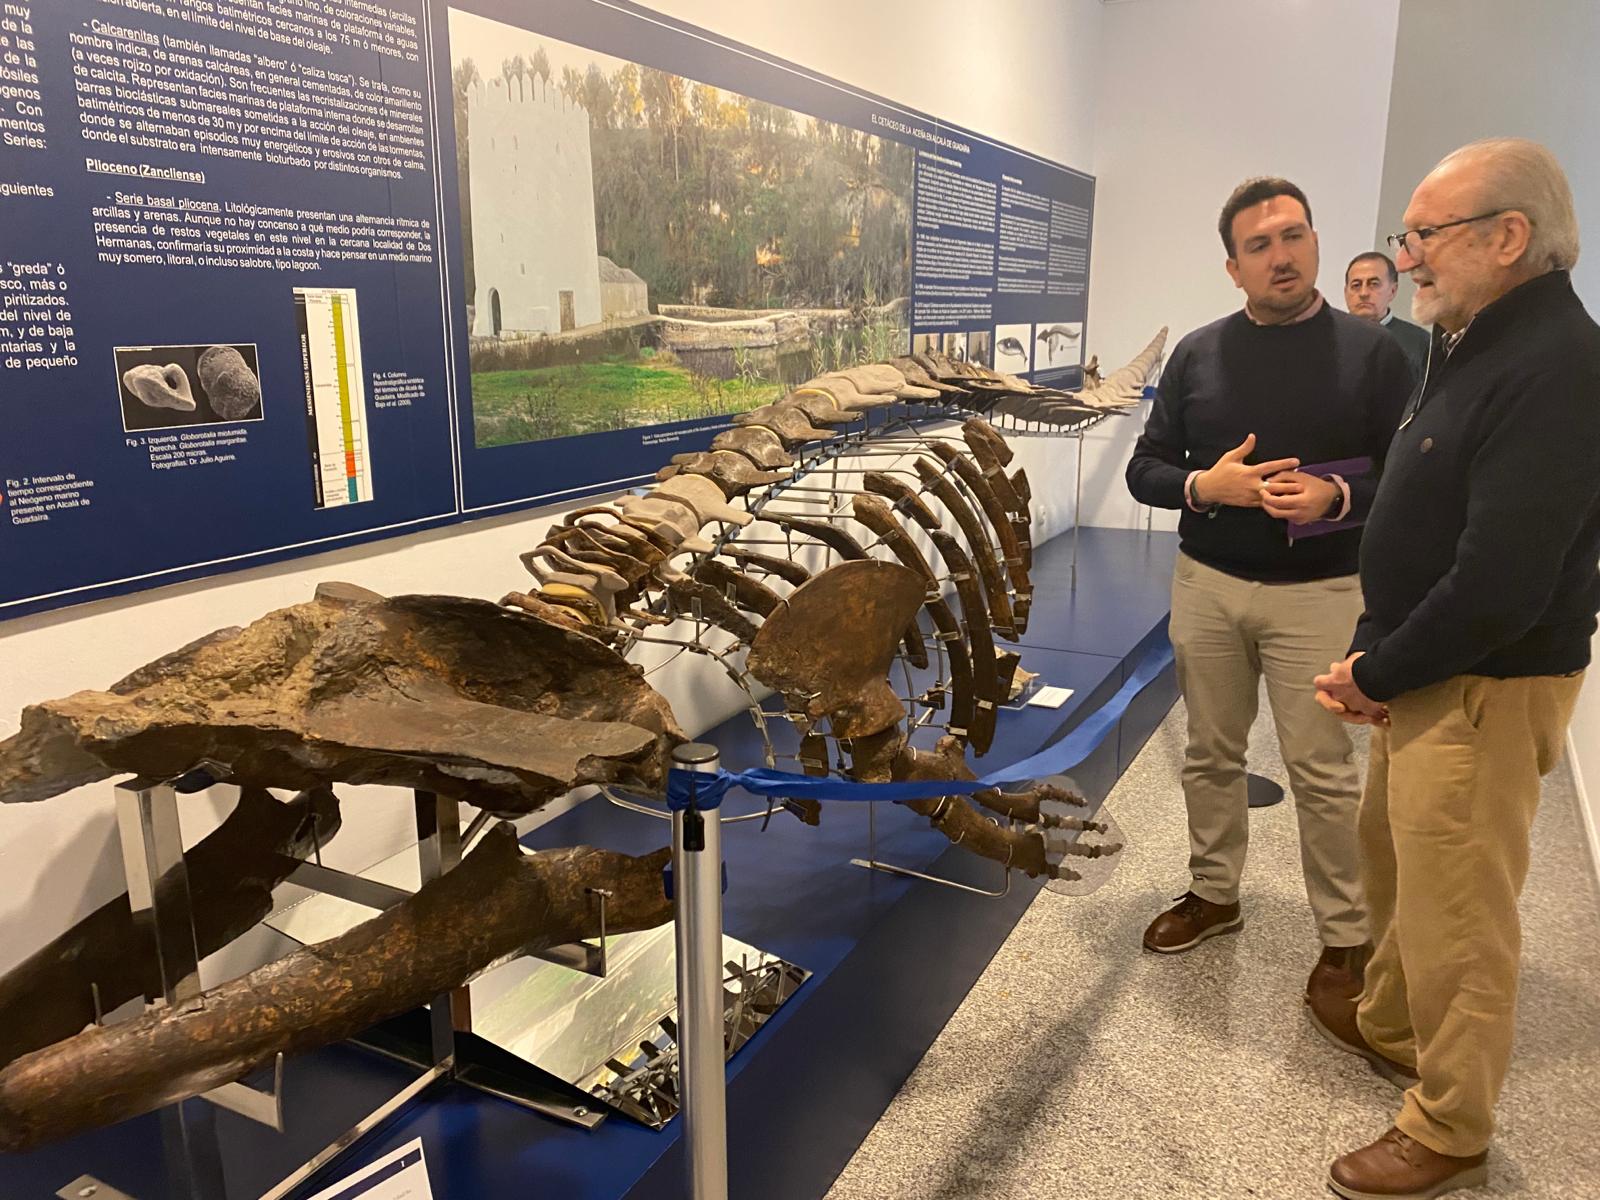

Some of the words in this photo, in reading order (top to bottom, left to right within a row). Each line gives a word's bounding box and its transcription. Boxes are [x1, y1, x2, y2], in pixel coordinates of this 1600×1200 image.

[5, 4, 30, 20] muy
[1, 18, 17, 31] de
[21, 20, 32, 34] la
[16, 36, 35, 50] las
[4, 50, 20, 64] de
[25, 53, 36, 68] la
[91, 19, 160, 44] Calcarenitas
[162, 34, 206, 53] (también
[209, 44, 251, 62] llamadas
[290, 61, 296, 72] ó
[358, 76, 369, 87] Se
[371, 78, 389, 93] trata,
[391, 85, 411, 96] como
[412, 90, 421, 98] su
[69, 33, 112, 49] nombre
[115, 39, 150, 59] indica,
[153, 47, 166, 59] de
[168, 53, 202, 67] arenas
[205, 59, 252, 79] calcáreas,
[254, 70, 266, 79] en
[268, 73, 300, 86] general
[302, 80, 352, 98] cementadas,
[354, 88, 364, 99] de
[365, 91, 382, 102] color
[0, 86, 41, 100] genos
[16, 101, 43, 116] Con
[0, 118, 46, 132] mentos
[3, 132, 48, 149] Series:
[86, 158, 138, 175] Plioceno
[139, 164, 206, 184] (Zancliense)
[0, 182, 54, 196] guientes
[115, 190, 143, 203] Serie
[147, 193, 175, 206] basal
[178, 197, 222, 210] pliocena.
[225, 201, 293, 217] Litológicamente
[296, 210, 336, 220] presentan
[396, 217, 419, 227] rítmica
[420, 218, 429, 228] de
[92, 205, 130, 218] arcillas
[133, 210, 140, 221] y
[143, 211, 181, 221] arenas.
[184, 212, 221, 226] Aunque
[224, 217, 236, 225] no
[238, 216, 255, 229] hay
[257, 220, 298, 230] concenso
[308, 222, 323, 233] qué
[325, 223, 349, 233] medio
[351, 225, 375, 236] podría
[376, 229, 423, 240] corresponder,
[423, 230, 430, 239] la
[94, 222, 146, 233] presencia
[152, 224, 165, 235] de
[170, 226, 200, 237] restos
[205, 228, 249, 241] vegetales
[254, 233, 265, 241] en
[269, 232, 288, 242] este
[291, 233, 311, 244] nivel
[328, 235, 336, 245] la
[339, 238, 369, 247] cercana
[372, 238, 403, 249] localidad
[405, 241, 414, 250] de
[417, 241, 431, 251] Dos
[96, 234, 154, 250] Hermanas,
[156, 239, 211, 251] confirmaría
[213, 244, 224, 252] su
[226, 243, 274, 255] proximidad
[276, 247, 281, 255] a
[282, 245, 290, 255] la
[292, 247, 313, 256] costa
[315, 249, 319, 259] y
[321, 247, 340, 258] hace
[341, 251, 366, 260] pensar
[388, 251, 408, 261] medio
[409, 253, 431, 262] marino
[98, 252, 121, 264] muy
[123, 254, 165, 265] somero,
[166, 253, 196, 267] litoral,
[197, 257, 204, 265] o
[205, 255, 238, 266] incluso
[239, 257, 274, 270] salobre,
[274, 258, 291, 270] tipo
[291, 259, 321, 271] lagoon.
[57, 264, 65, 275] ó
[30, 278, 56, 290] más
[59, 281, 67, 290] o
[4, 294, 69, 308] piritizados.
[0, 309, 18, 321] del
[23, 309, 51, 321] nivel
[56, 310, 71, 320] de
[17, 327, 24, 339] y
[28, 325, 44, 336] de
[48, 324, 74, 338] baja
[0, 341, 42, 352] ntarias
[50, 342, 57, 353] y
[64, 340, 76, 351] la
[5, 356, 21, 368] de
[26, 355, 78, 370] pequeño
[32, 475, 64, 484] Intervalo
[8, 488, 34, 497] tiempo
[35, 480, 94, 493] correspondiente
[18, 495, 52, 505] Neógeno
[54, 491, 80, 499] marino
[11, 505, 44, 517] presente
[57, 500, 79, 509] Alcalá
[80, 498, 90, 506] de
